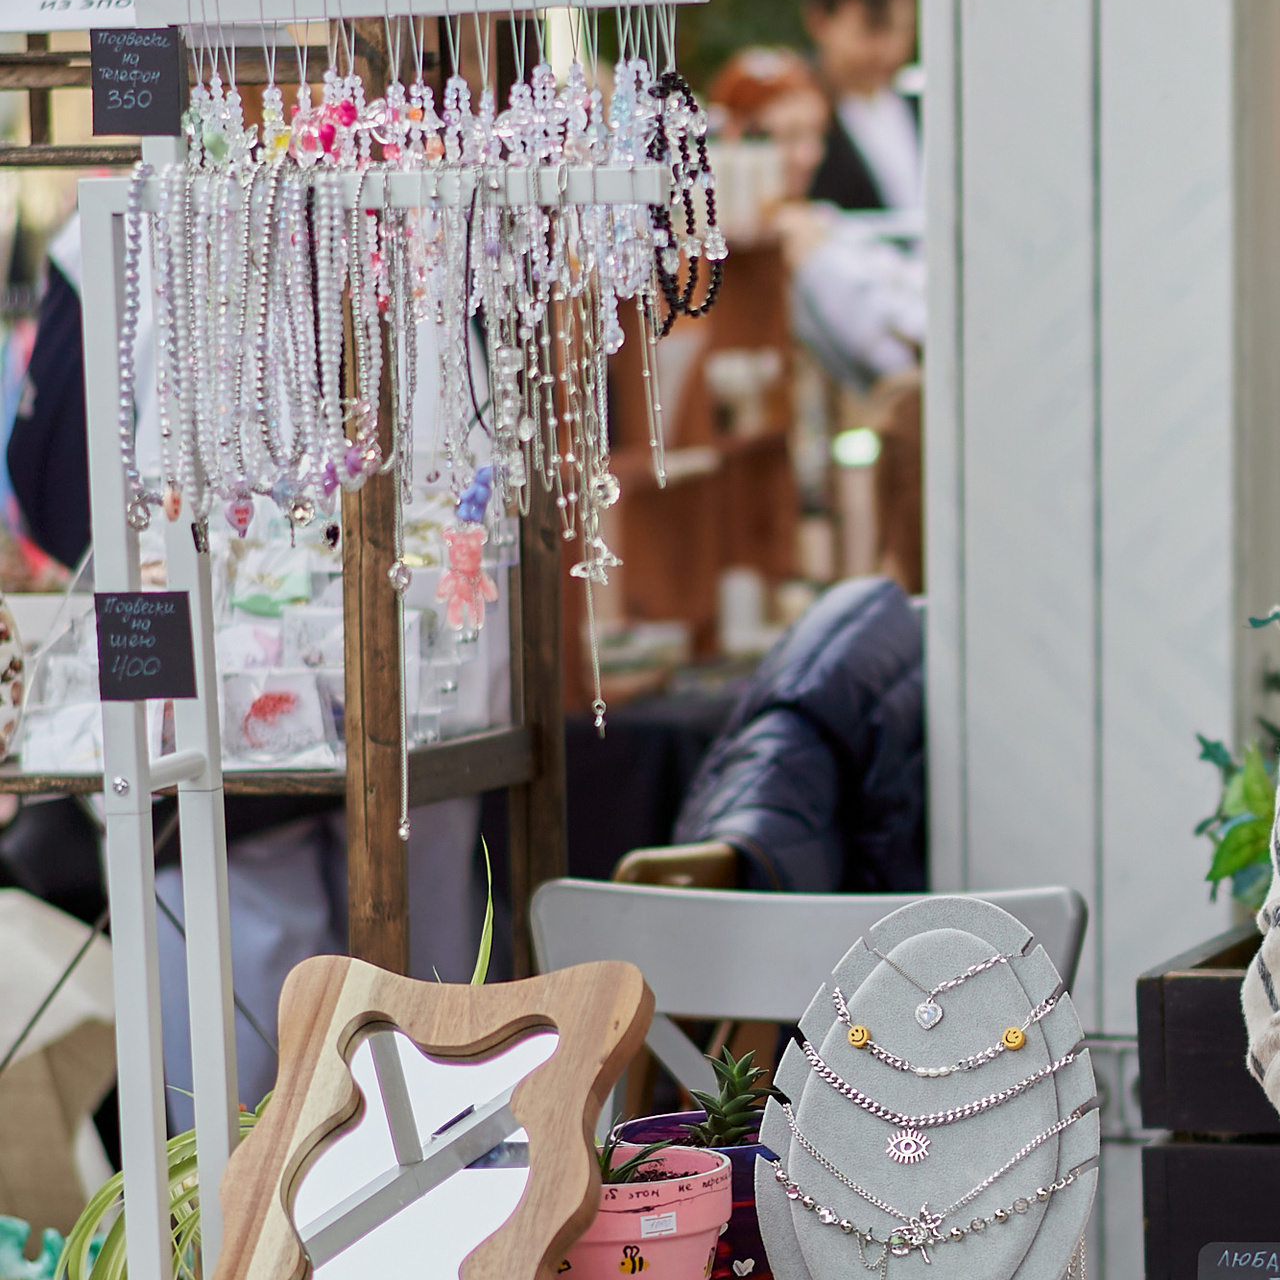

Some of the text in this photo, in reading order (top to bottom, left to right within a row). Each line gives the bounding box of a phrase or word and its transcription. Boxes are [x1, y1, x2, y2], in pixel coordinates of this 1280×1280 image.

[39, 0, 70, 11] ИЗ
[97, 32, 171, 52] Подвески
[122, 52, 140, 67] на
[106, 89, 153, 110] 350
[104, 596, 175, 623] Подвески
[110, 633, 156, 649] шею
[112, 654, 161, 682] 400
